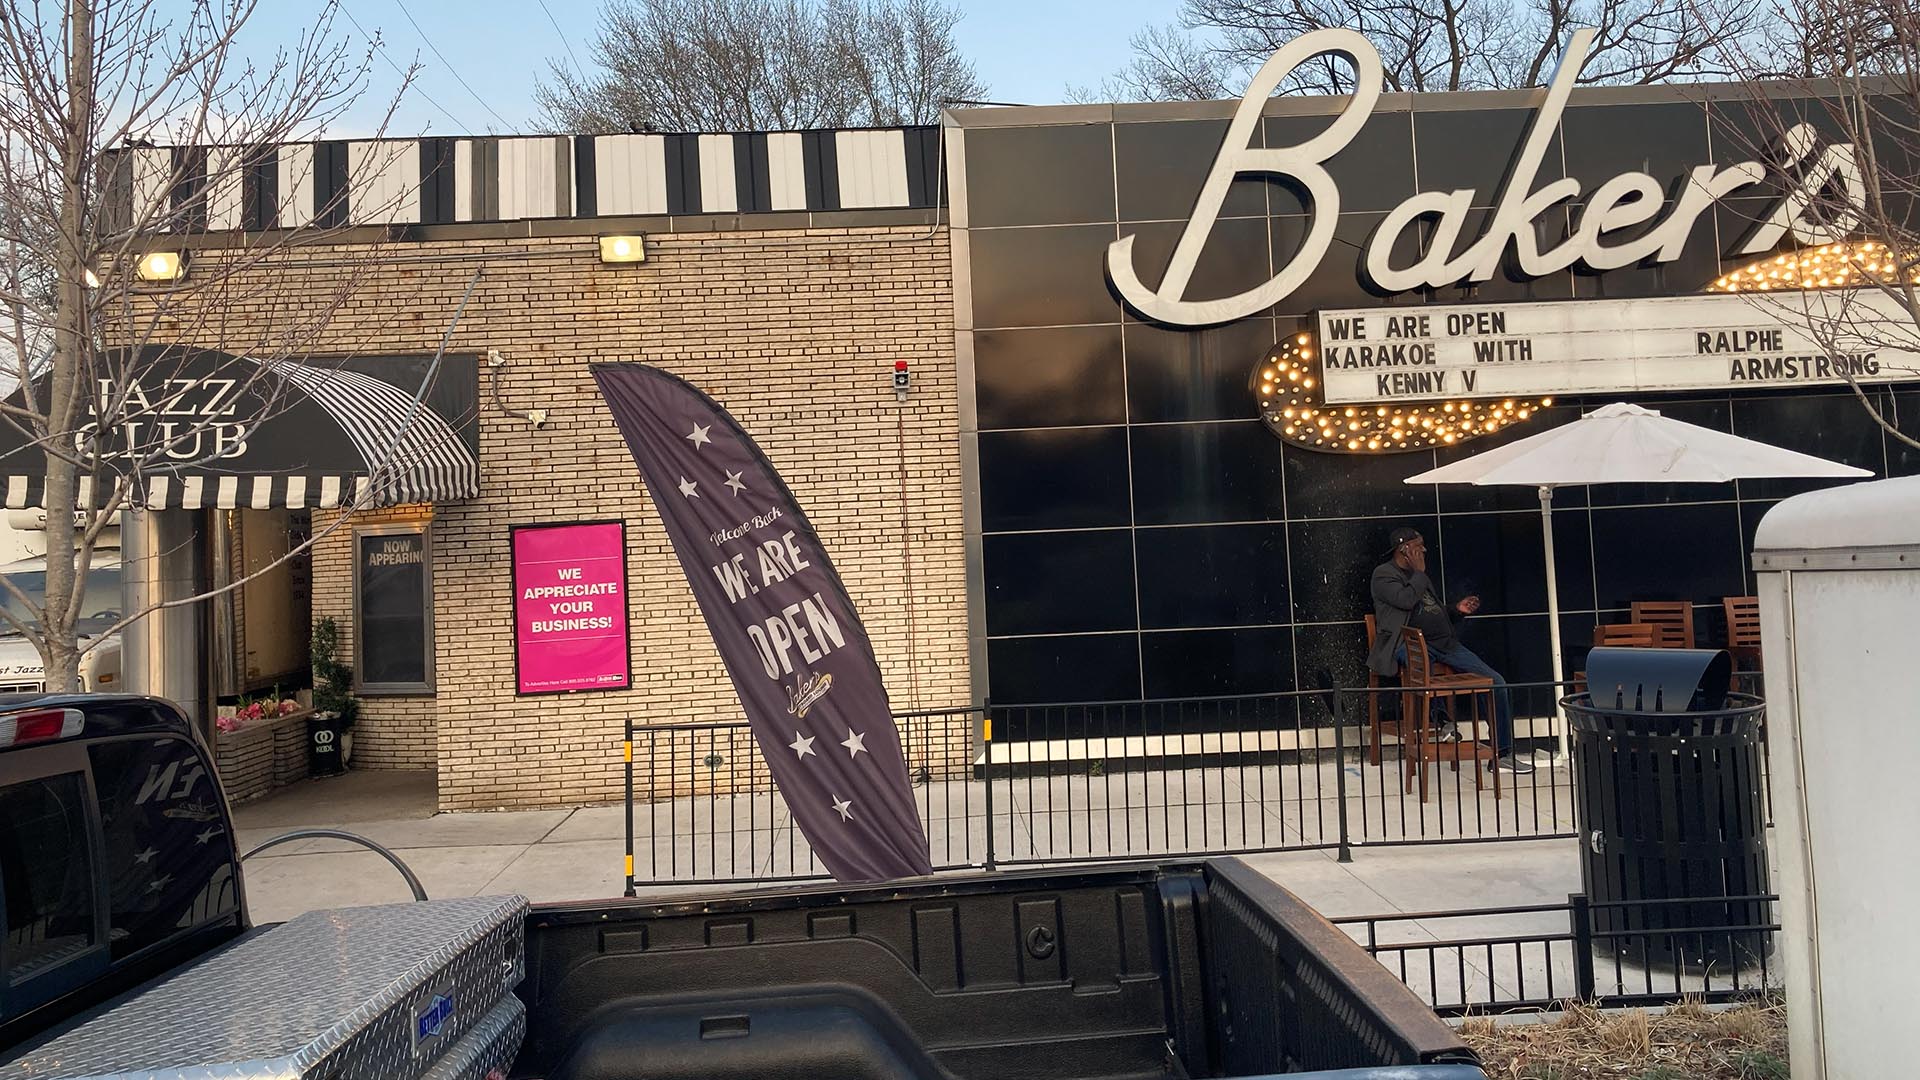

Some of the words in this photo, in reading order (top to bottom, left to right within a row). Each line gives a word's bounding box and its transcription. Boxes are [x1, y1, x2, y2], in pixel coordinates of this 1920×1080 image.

[1107, 27, 1867, 326] Baker's
[1328, 317, 1366, 340] WE
[1386, 315, 1431, 338] ARE
[1447, 311, 1506, 336] OPEN
[1325, 343, 1436, 369] KARAKOE
[1473, 339, 1533, 363] WITH
[1697, 329, 1784, 354] RALPHE
[1730, 352, 1880, 381] ARMSTRONG
[88, 378, 237, 415] JAZZ
[1377, 371, 1445, 396] KENNY
[1461, 370, 1477, 392] V
[75, 421, 248, 459] CLUB
[751, 506, 784, 529] Back
[383, 540, 412, 553] NOW
[558, 568, 582, 580] WE
[712, 552, 760, 604] WE
[756, 530, 810, 587] ARE
[524, 582, 618, 600] APPRECIATE
[550, 601, 594, 615] YOUR
[532, 616, 612, 633] BUSINESS!
[746, 592, 846, 680] OPEN
